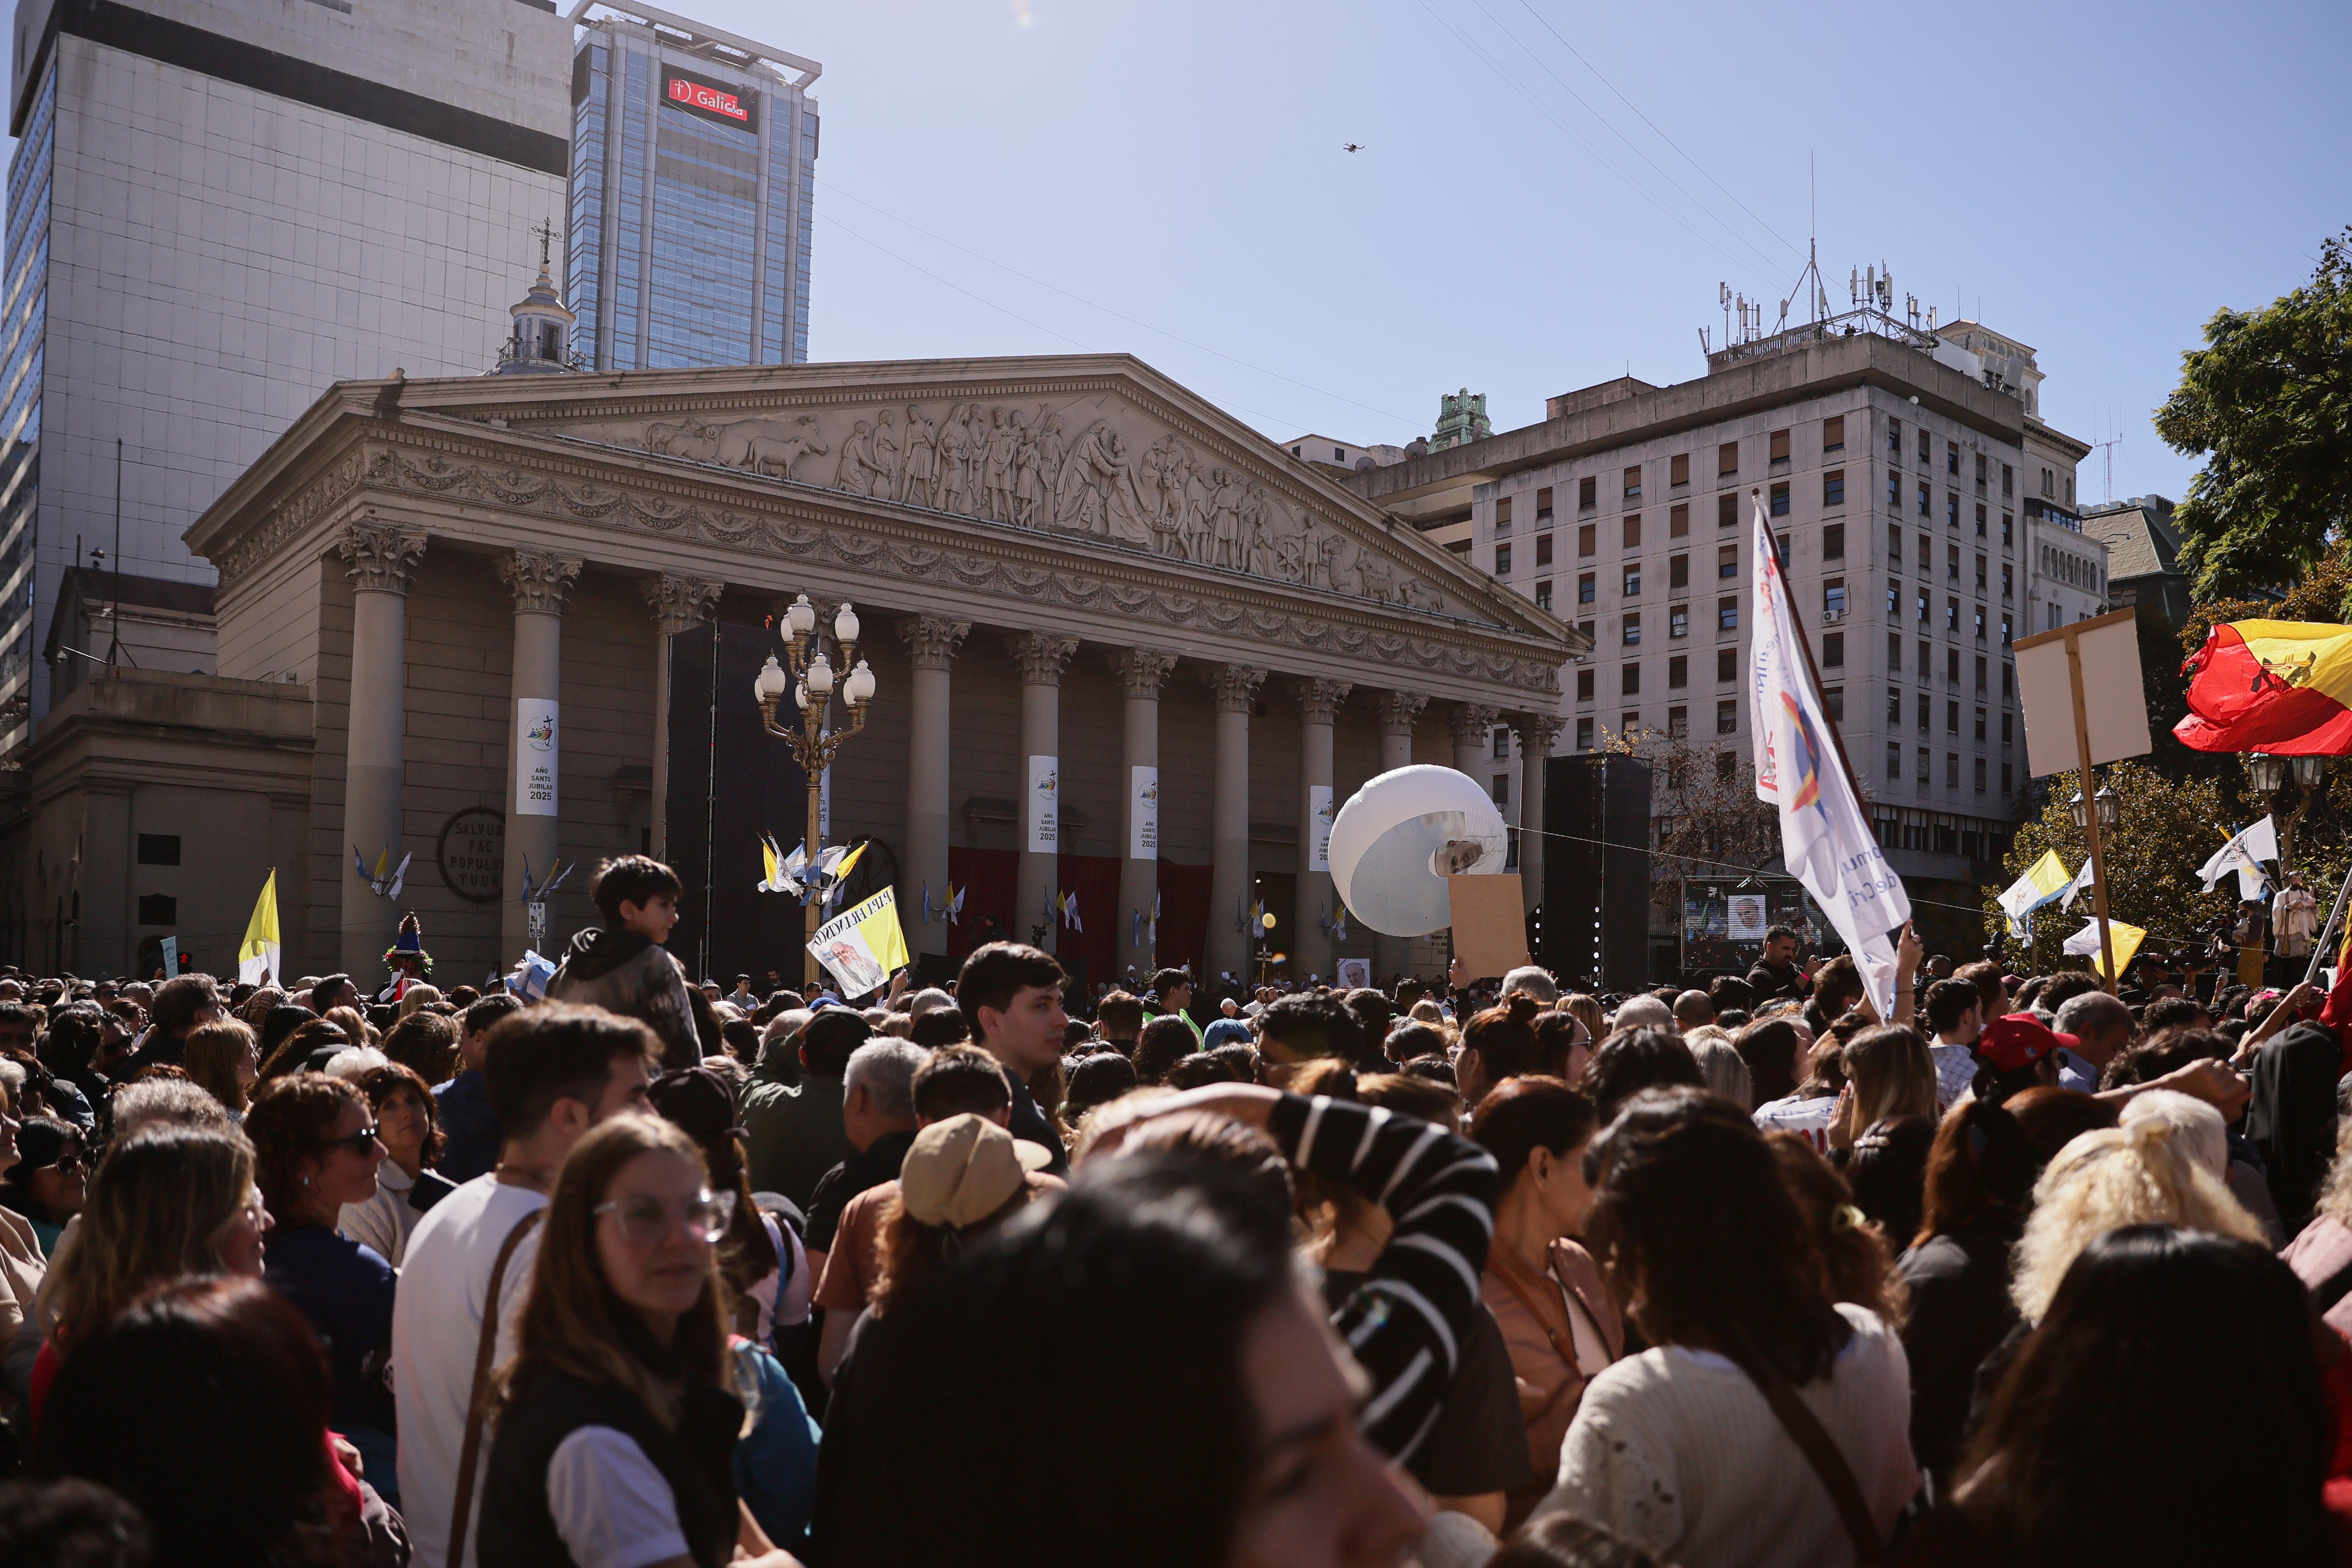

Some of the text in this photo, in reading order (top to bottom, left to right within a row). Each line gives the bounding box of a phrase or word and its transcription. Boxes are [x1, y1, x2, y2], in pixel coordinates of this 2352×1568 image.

[697, 91, 743, 116] Galicia
[530, 791, 551, 800] 2025
[469, 840, 493, 852] FAC
[450, 856, 504, 870] POPULU
